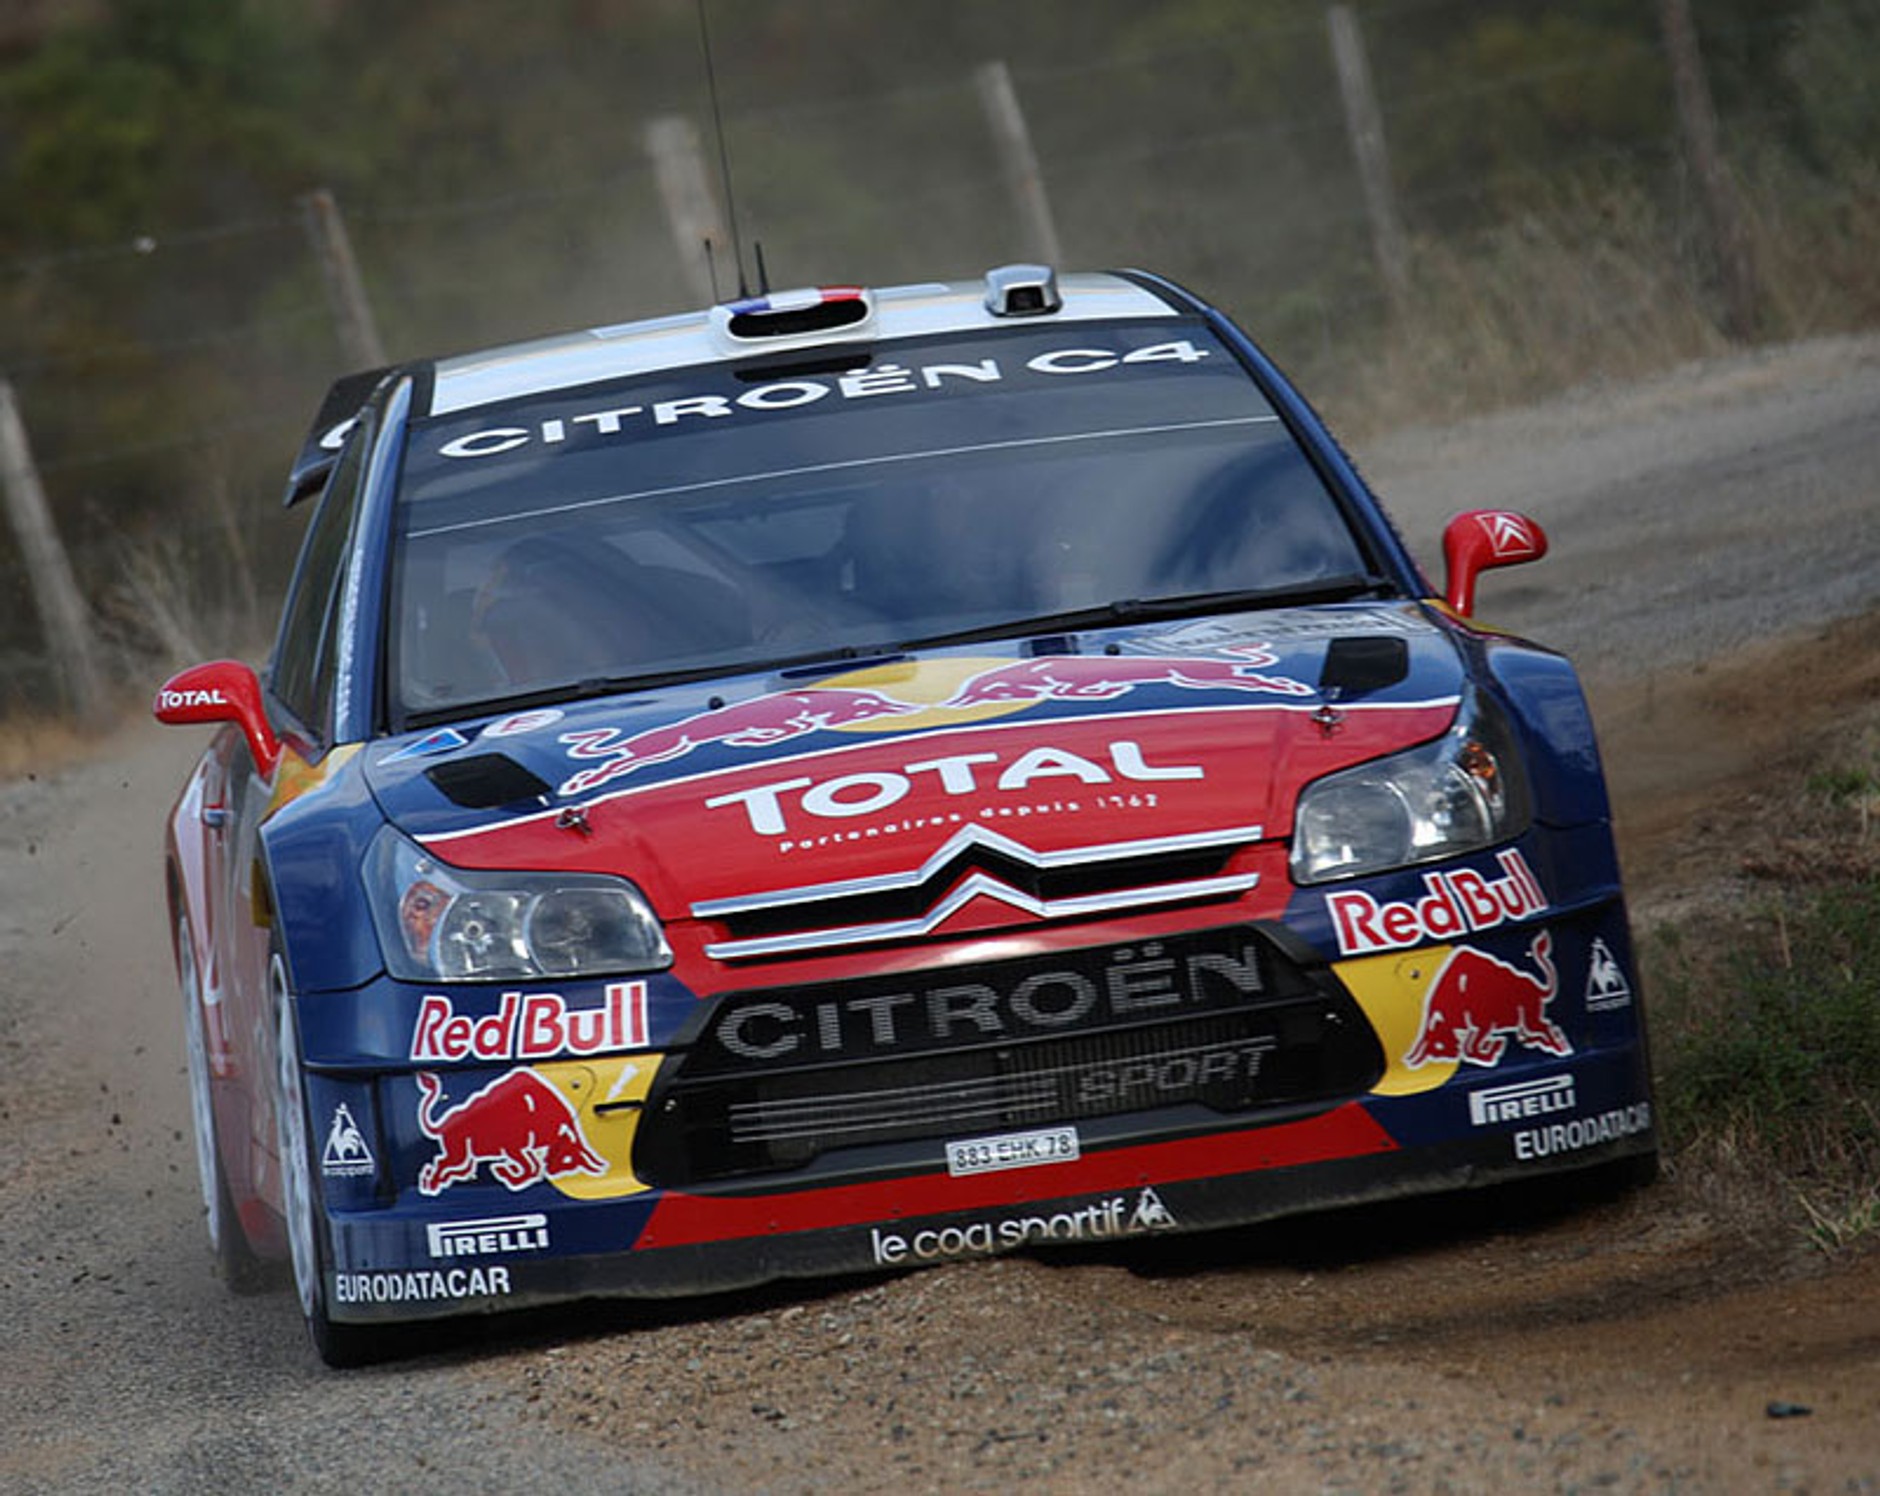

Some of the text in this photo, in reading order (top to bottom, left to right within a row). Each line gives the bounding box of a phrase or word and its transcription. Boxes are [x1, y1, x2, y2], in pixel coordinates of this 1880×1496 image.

[439, 359, 1001, 457] CITROËN
[1026, 340, 1208, 373] C4
[161, 689, 227, 709] TOTAL
[705, 741, 1204, 835] TOTAL
[716, 942, 1264, 1059] CITROËN
[1079, 1045, 1277, 1101] SPORT
[1469, 1074, 1576, 1125] PIRELLI
[956, 1145, 992, 1168] 883
[1045, 1134, 1070, 1155] 78
[427, 1214, 549, 1257] PIRELLI
[871, 1228, 908, 1265] le
[914, 1223, 993, 1258] coq
[336, 1267, 510, 1301] EURODATACAR
